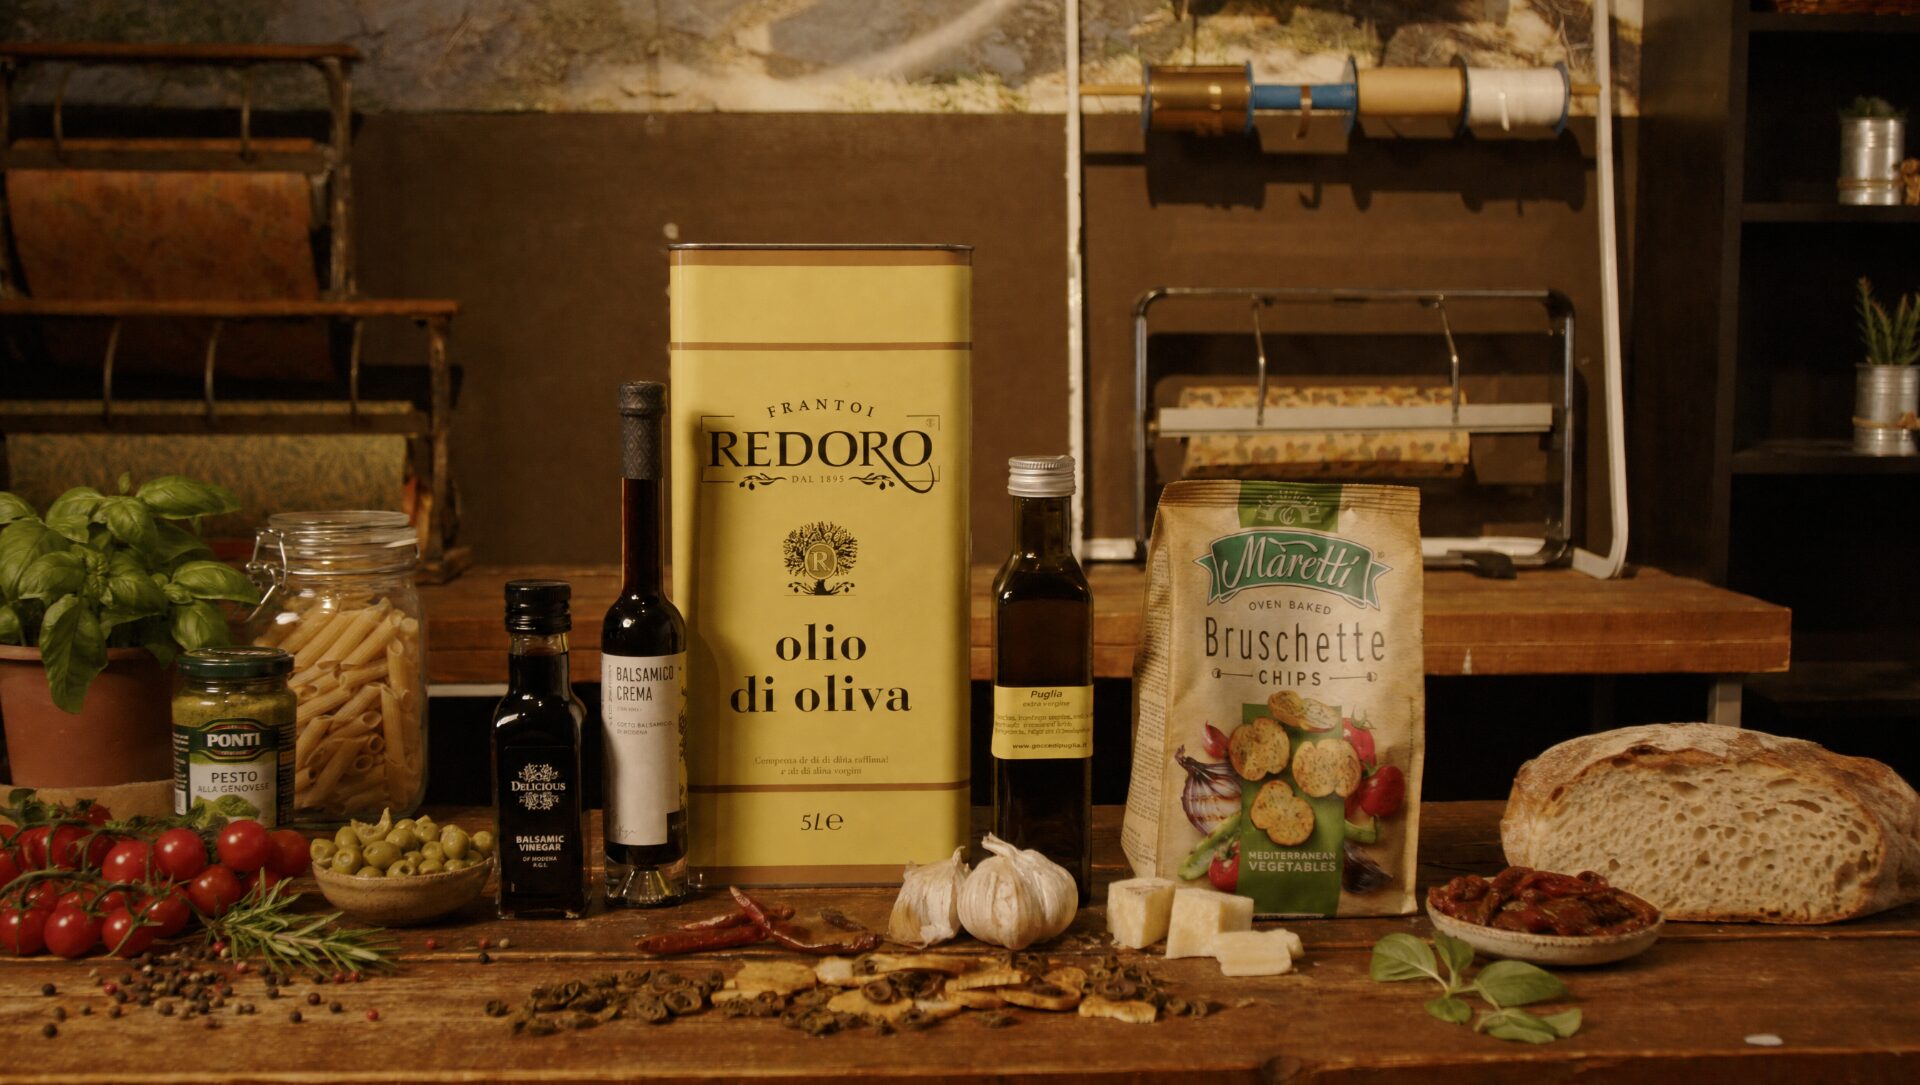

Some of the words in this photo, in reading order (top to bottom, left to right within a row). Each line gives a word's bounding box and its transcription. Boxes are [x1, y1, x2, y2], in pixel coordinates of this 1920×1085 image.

[767, 398, 875, 418] FRANTOI
[707, 430, 935, 493] REDORO
[791, 475, 814, 483] DAL
[820, 475, 845, 484] 1895
[811, 551, 831, 572] R
[1249, 600, 1282, 611] OVEN
[1289, 600, 1332, 615] BAKED
[775, 623, 866, 661] olio
[1205, 616, 1385, 663] Bruschette
[616, 665, 674, 682] BALSAMICO
[1258, 669, 1322, 687] CHIPS
[616, 685, 653, 702] CREMA
[730, 675, 777, 713] di
[794, 674, 912, 712] oliva
[1030, 690, 1063, 700] Puglia
[206, 732, 261, 747] PONTI
[211, 771, 258, 784] PESTO
[197, 784, 218, 793] ALLA
[221, 782, 270, 793] GENOVESE
[516, 835, 565, 844] BALSAMIC
[1248, 851, 1337, 861] MEDITERRANEAN
[1248, 860, 1337, 873] VEGETABLES
